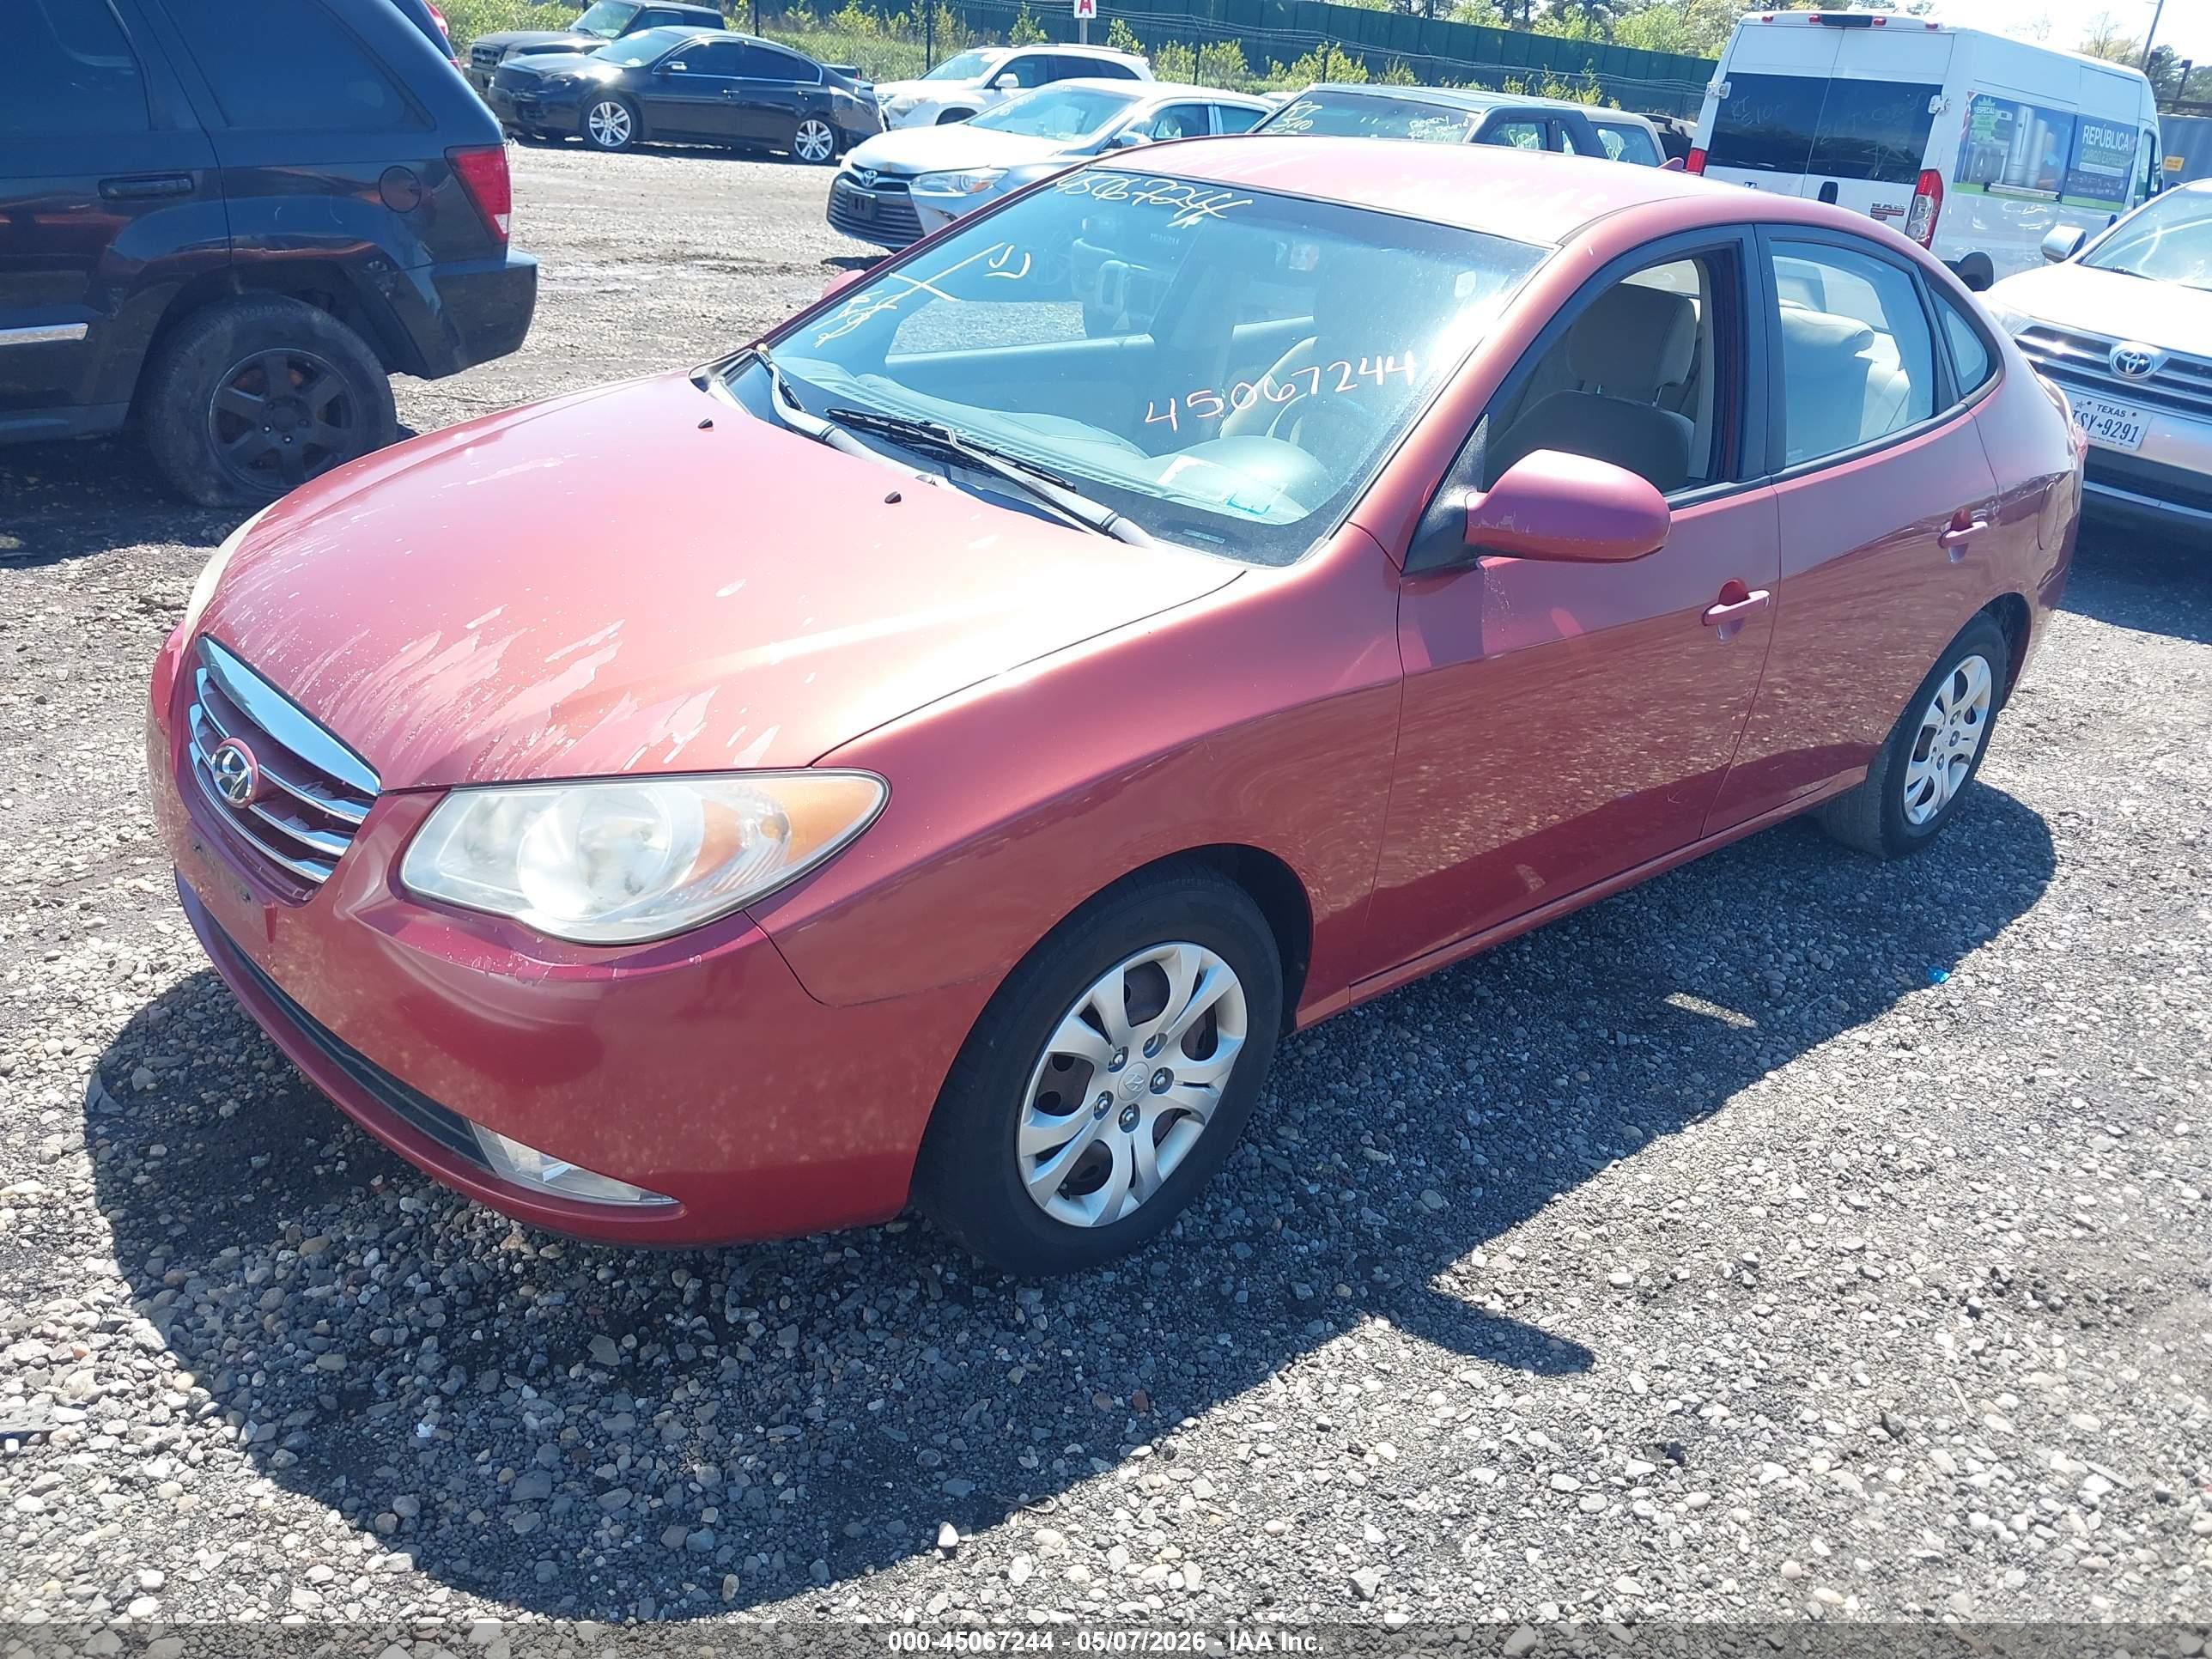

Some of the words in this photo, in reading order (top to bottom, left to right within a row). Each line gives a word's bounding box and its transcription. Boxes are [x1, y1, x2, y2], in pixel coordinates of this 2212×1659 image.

[1079, 0, 1092, 14] A
[2082, 124, 2130, 151] REPÚBLICA
[1145, 349, 1418, 433] 45067244
[2097, 404, 2127, 417] TEXAS
